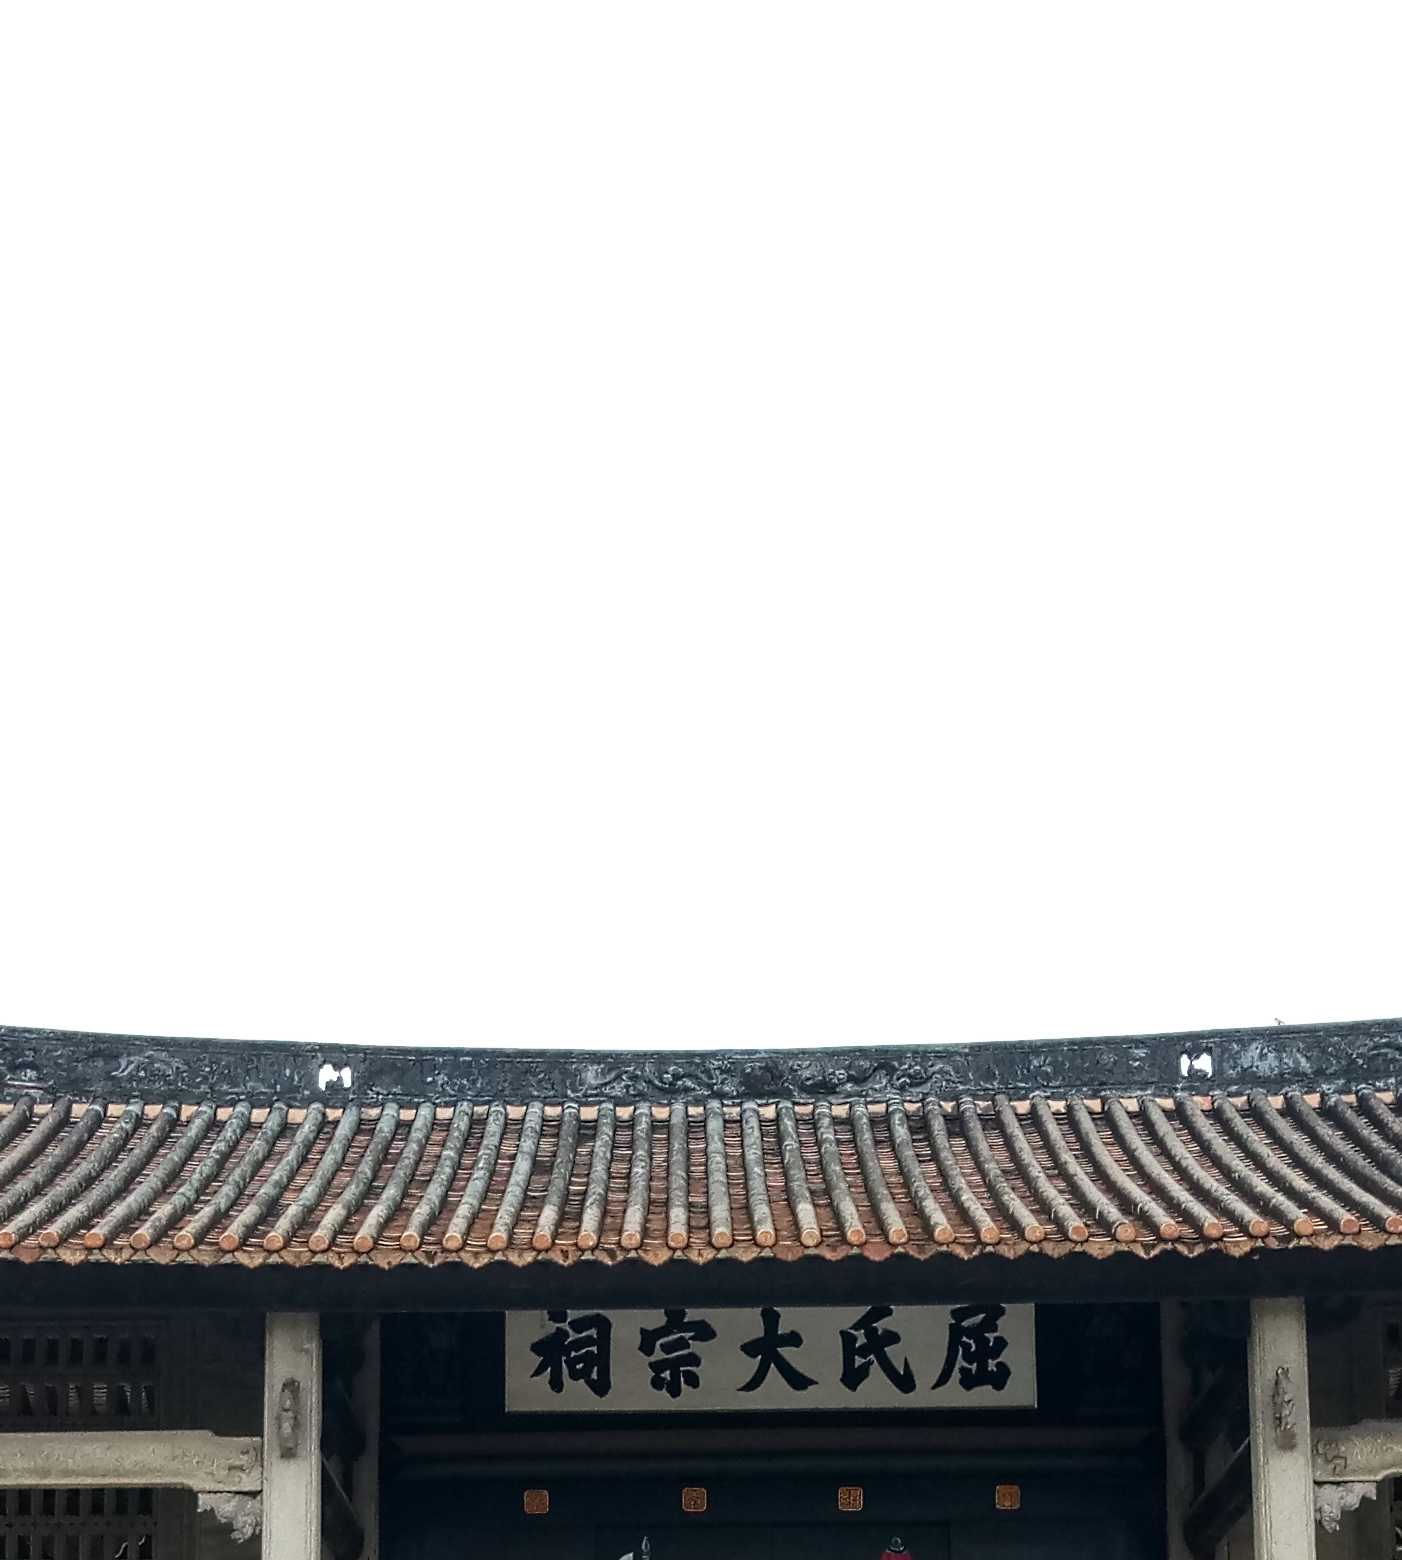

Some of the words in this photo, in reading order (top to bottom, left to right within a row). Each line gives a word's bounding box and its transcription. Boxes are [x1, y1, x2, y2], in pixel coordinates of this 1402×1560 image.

[529, 1304, 1012, 1398] 屈氏大宗祠
